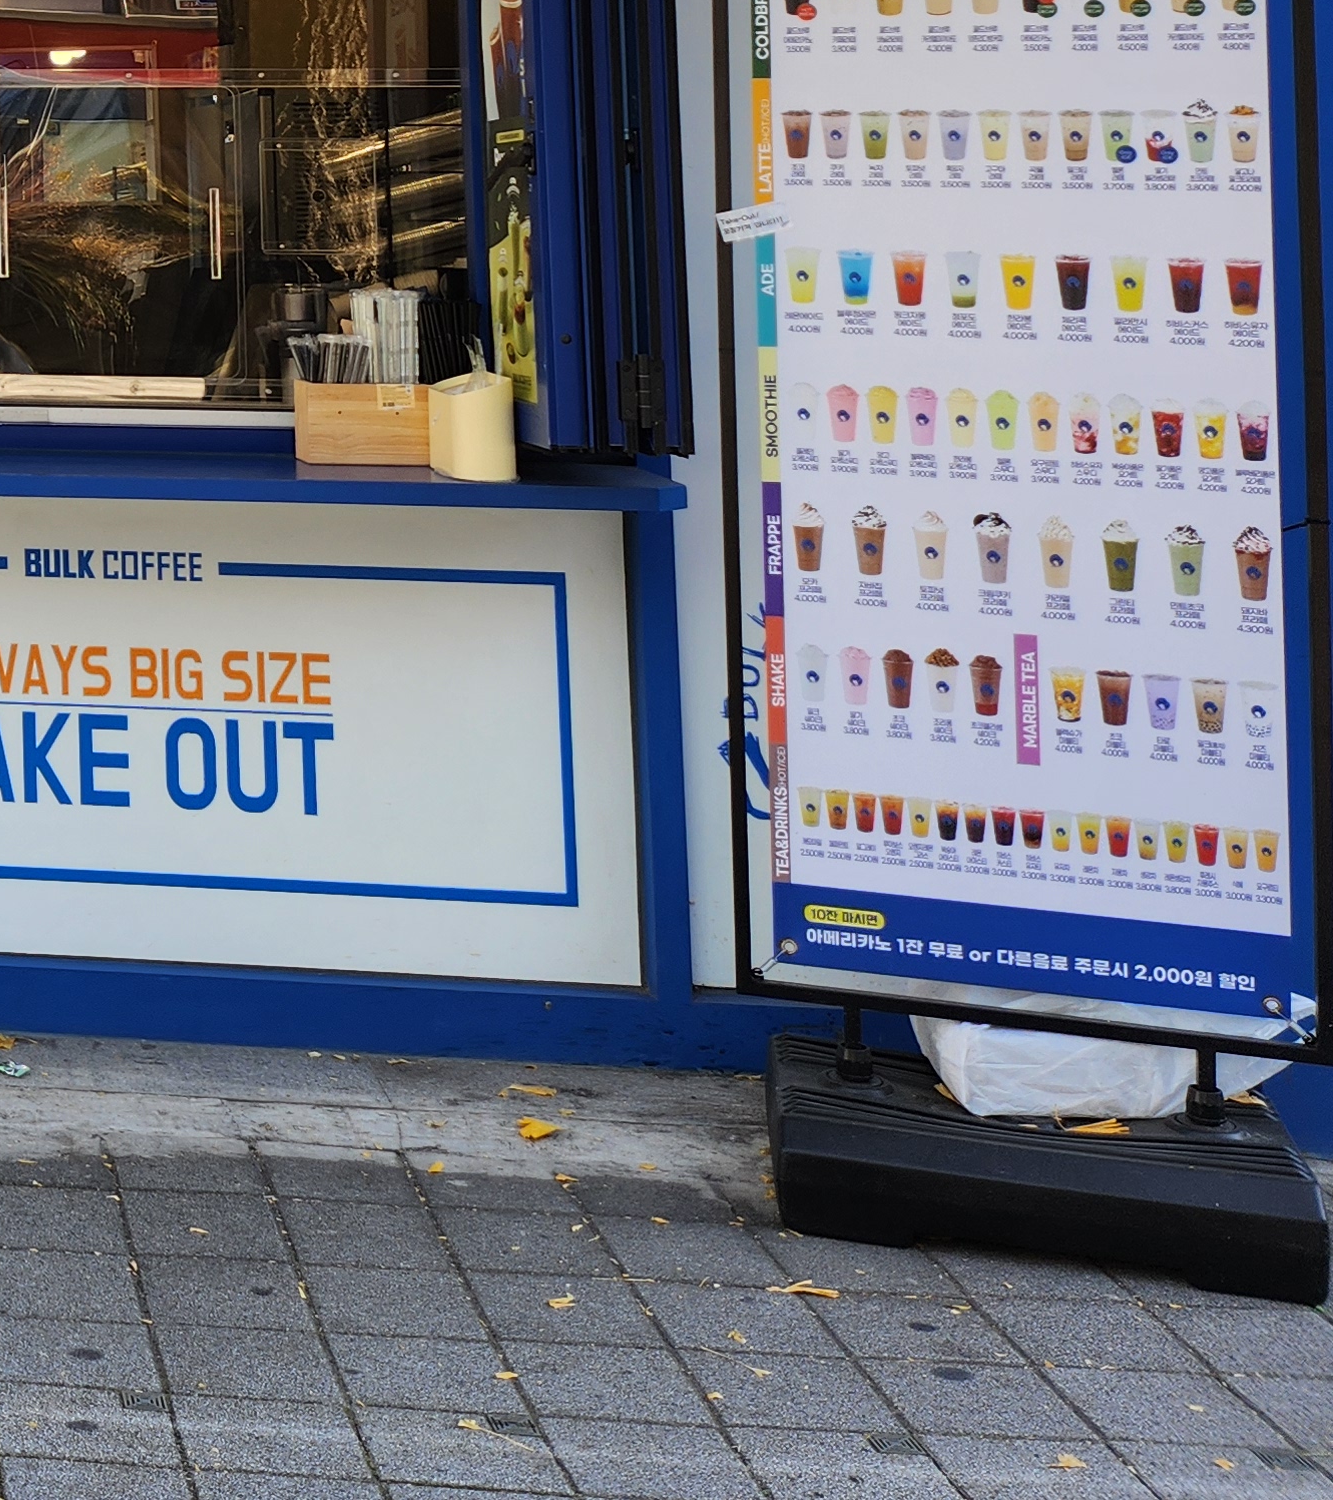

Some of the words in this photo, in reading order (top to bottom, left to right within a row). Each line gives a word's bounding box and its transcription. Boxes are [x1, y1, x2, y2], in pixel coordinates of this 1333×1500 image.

[761, 264, 774, 295] ADE
[25, 547, 96, 579] BULK
[103, 551, 203, 582] COFFEE
[767, 515, 782, 575] FRAPPE
[131, 647, 205, 701] BIG
[221, 650, 332, 705] SIZE
[771, 653, 784, 707] SHAKE
[1025, 651, 1038, 679] TEA
[1024, 682, 1038, 749] MARBLE
[165, 716, 335, 816] OUT
[842, 912, 878, 926] 마시면
[806, 928, 892, 953] 아메리카노
[896, 937, 923, 956] 1잔
[927, 941, 964, 961] 무료
[968, 948, 991, 964] or
[997, 949, 1069, 972] 다른음료
[1074, 958, 1129, 979] 주문시
[1218, 972, 1256, 993] 할인
